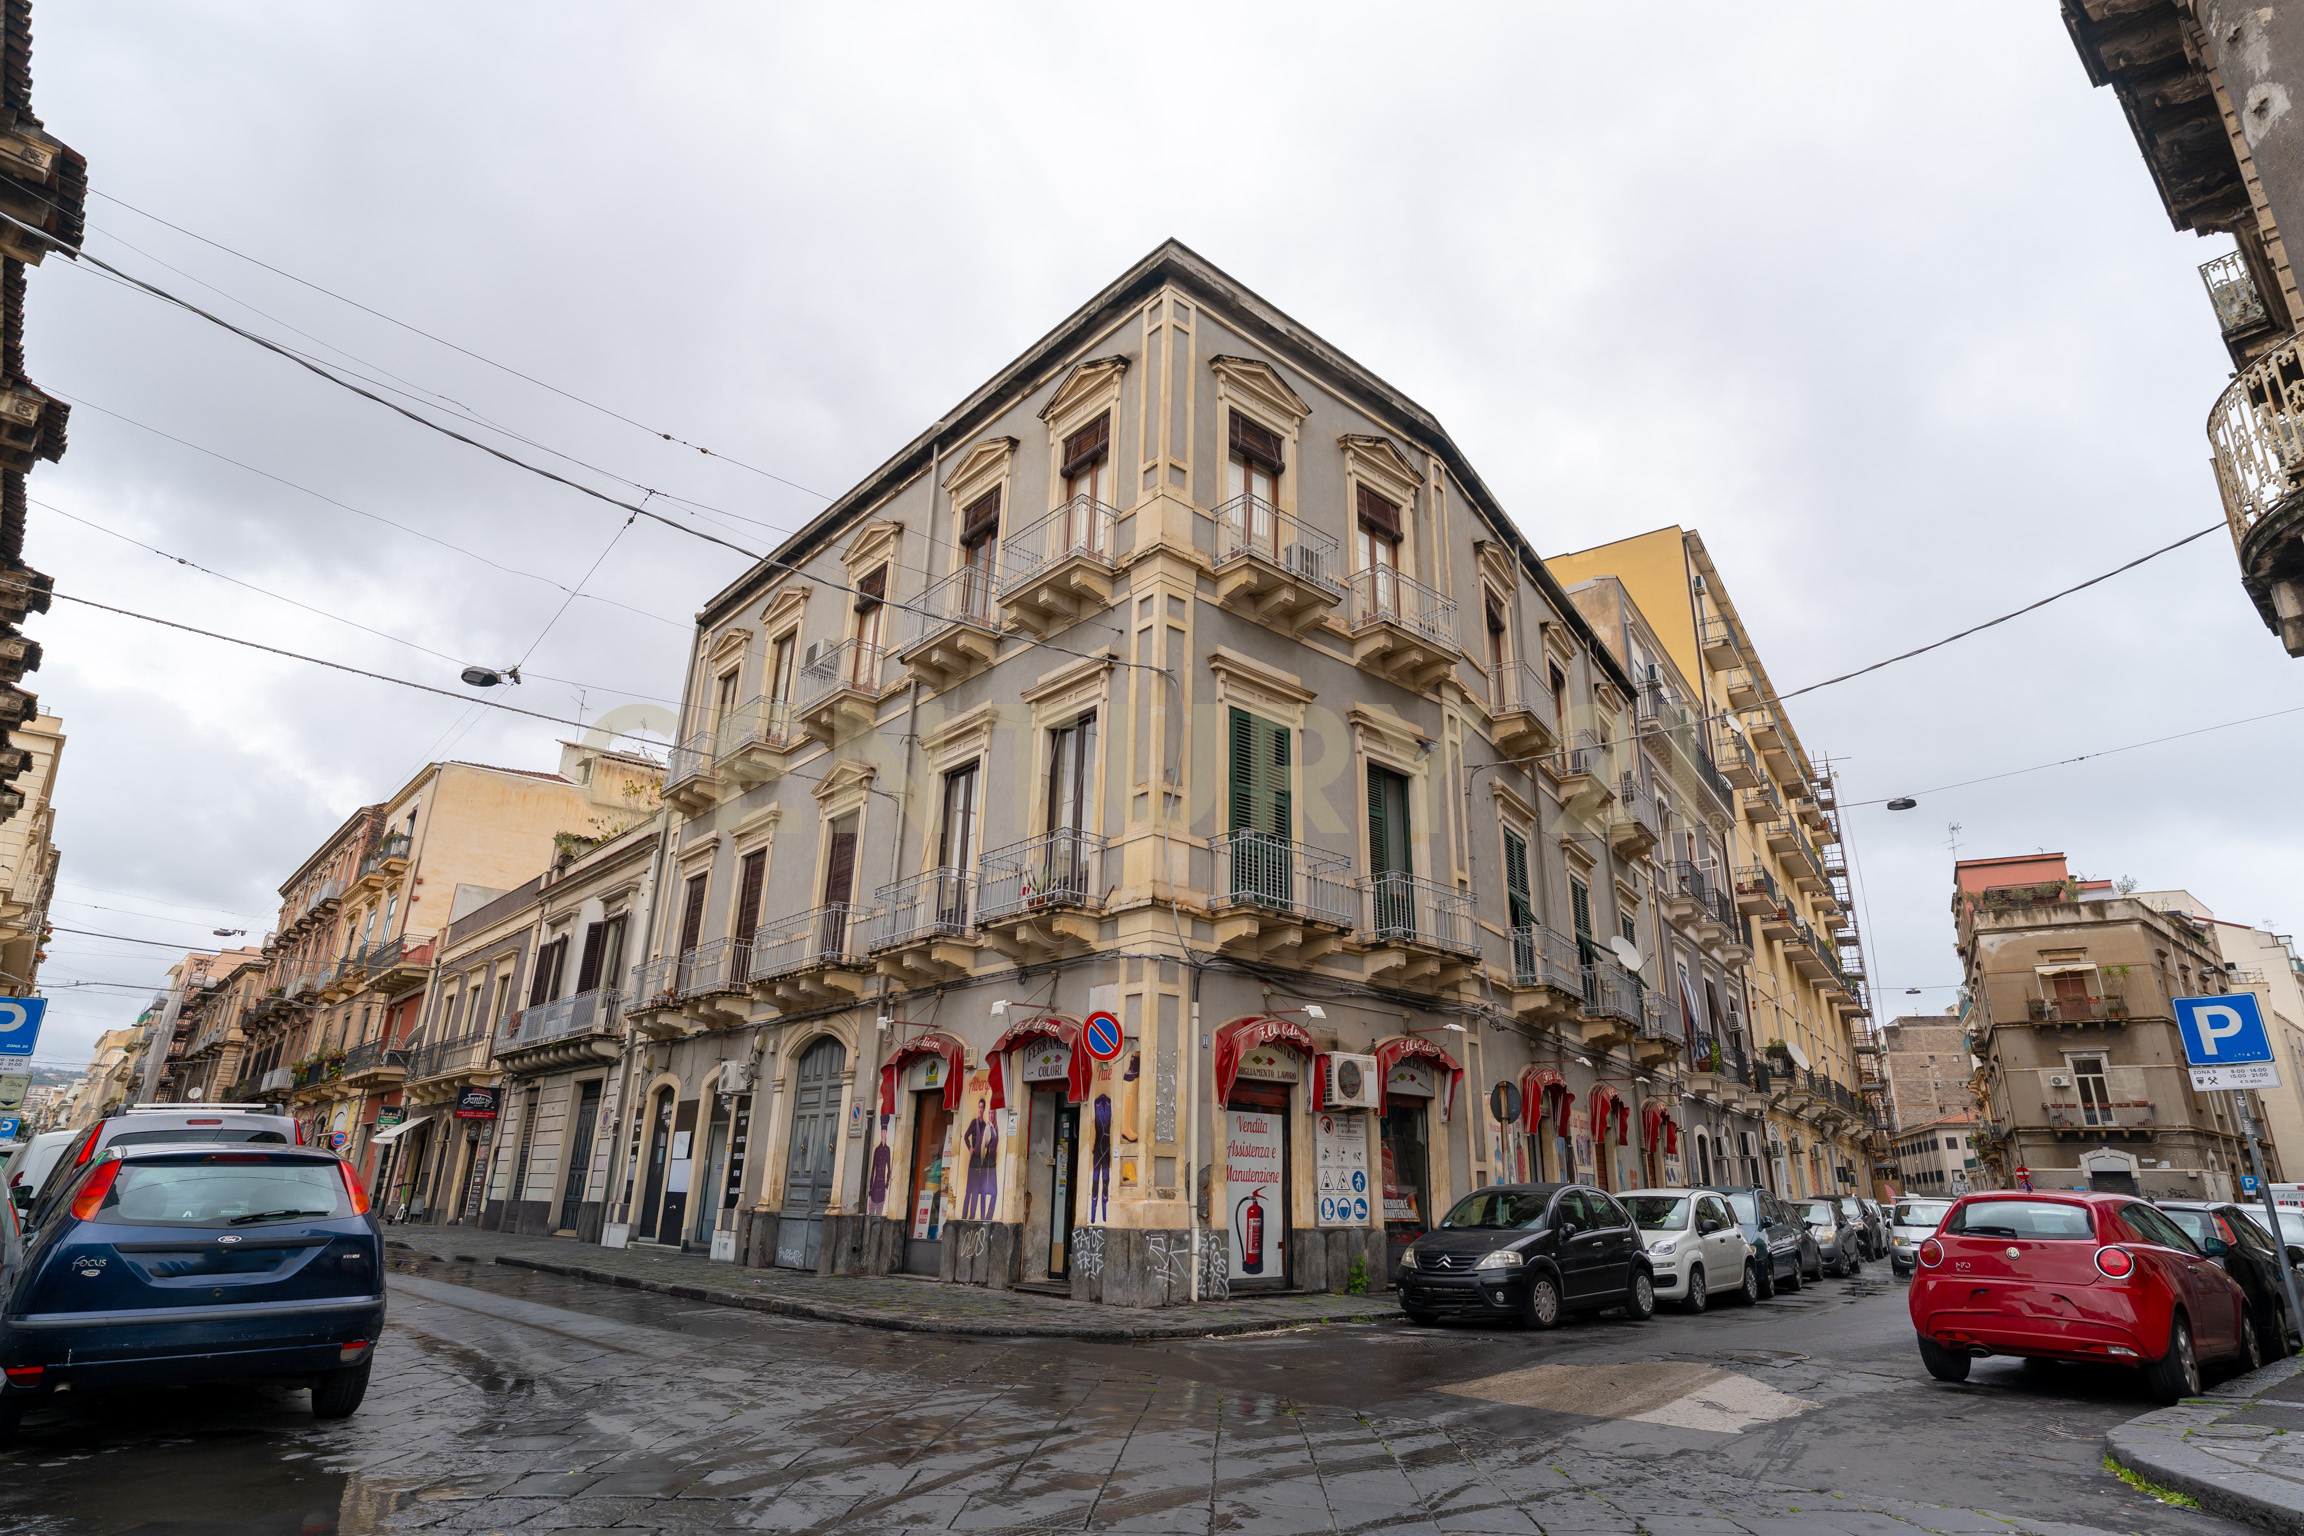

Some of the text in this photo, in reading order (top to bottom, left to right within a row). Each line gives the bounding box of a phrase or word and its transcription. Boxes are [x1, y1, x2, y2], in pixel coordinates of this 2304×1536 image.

[2192, 1005, 2243, 1056] P
[1038, 1064, 1062, 1077] COLORI
[1278, 1070, 1296, 1080] LAVORO
[1236, 1116, 1268, 1134] Vendita
[1227, 1140, 1276, 1159] Assistenza e
[2246, 1178, 2254, 1188] P
[1384, 1199, 1404, 1208] VENDITA
